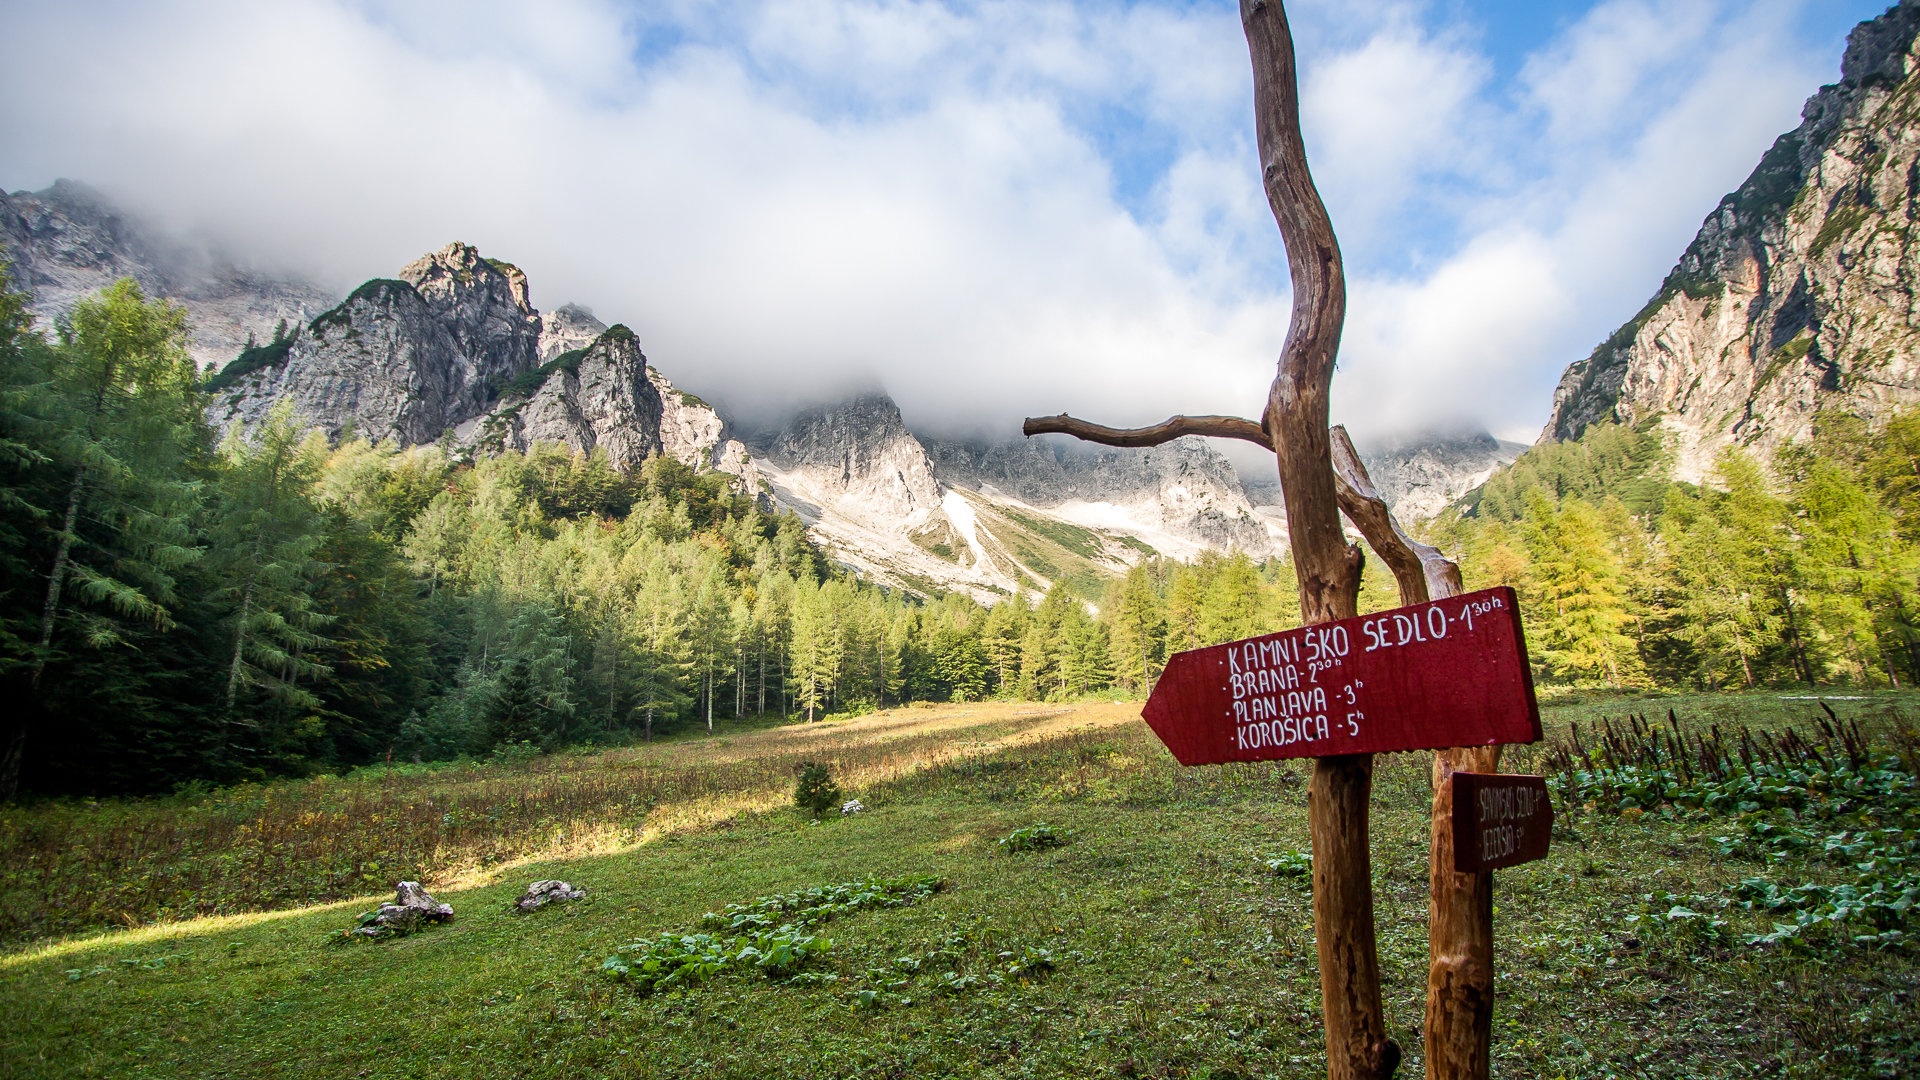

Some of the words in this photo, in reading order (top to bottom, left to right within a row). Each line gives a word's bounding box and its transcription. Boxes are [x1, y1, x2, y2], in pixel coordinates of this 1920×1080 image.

[1228, 626, 1349, 674] KAMNIŠKO
[1363, 607, 1447, 652] SEDLO
[1229, 664, 1300, 700] BRANA
[1233, 687, 1328, 723] PLANJAVA
[1237, 714, 1330, 750] KOROŠICA
